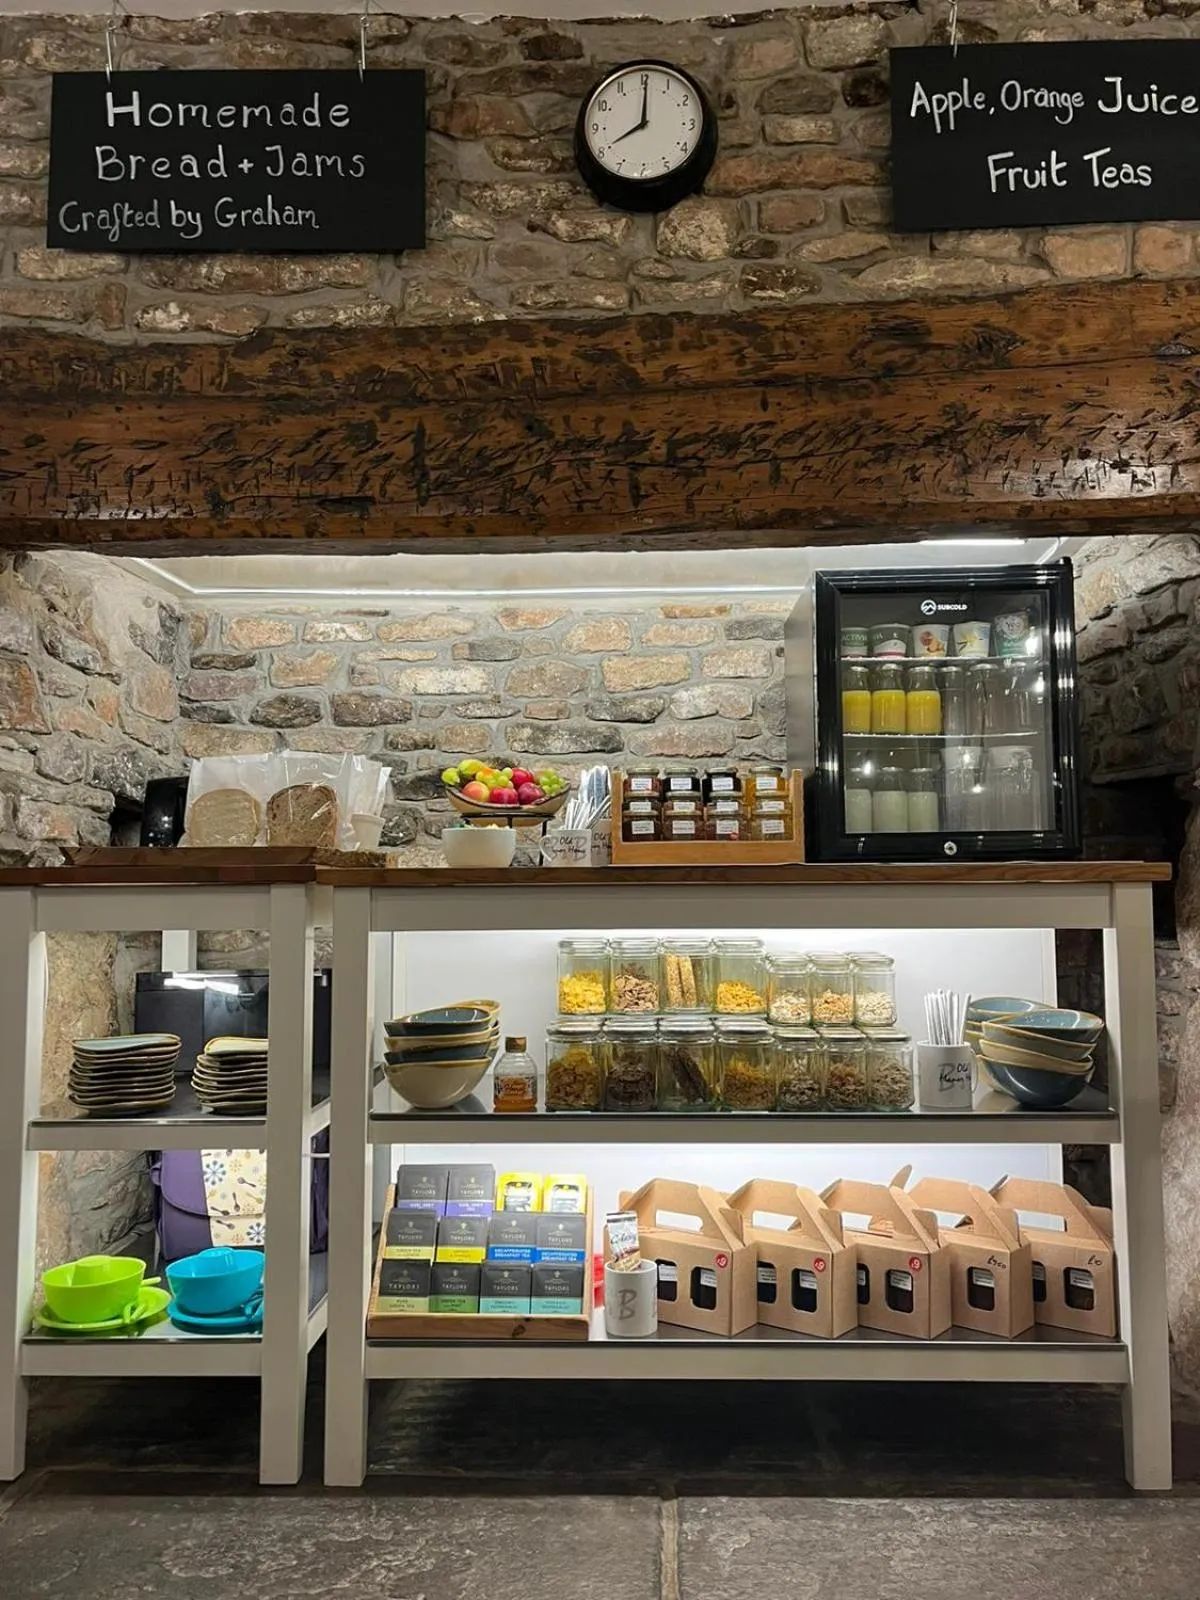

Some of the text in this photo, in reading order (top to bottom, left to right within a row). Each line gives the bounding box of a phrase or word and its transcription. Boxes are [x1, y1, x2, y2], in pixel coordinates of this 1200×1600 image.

[617, 81, 624, 93] 11
[598, 100, 608, 112] 10
[682, 95, 689, 107] 2
[910, 77, 1199, 134] Apple, Orange Juice
[105, 91, 350, 128] Homemade
[592, 123, 599, 135] 9
[688, 119, 696, 131] 3
[597, 147, 606, 159] 8
[680, 142, 688, 154] 4
[96, 144, 365, 182] Bread + Jams
[616, 163, 623, 173] 7
[988, 147, 1153, 193] Fruit Teas
[59, 194, 320, 241] Crafted by Graham
